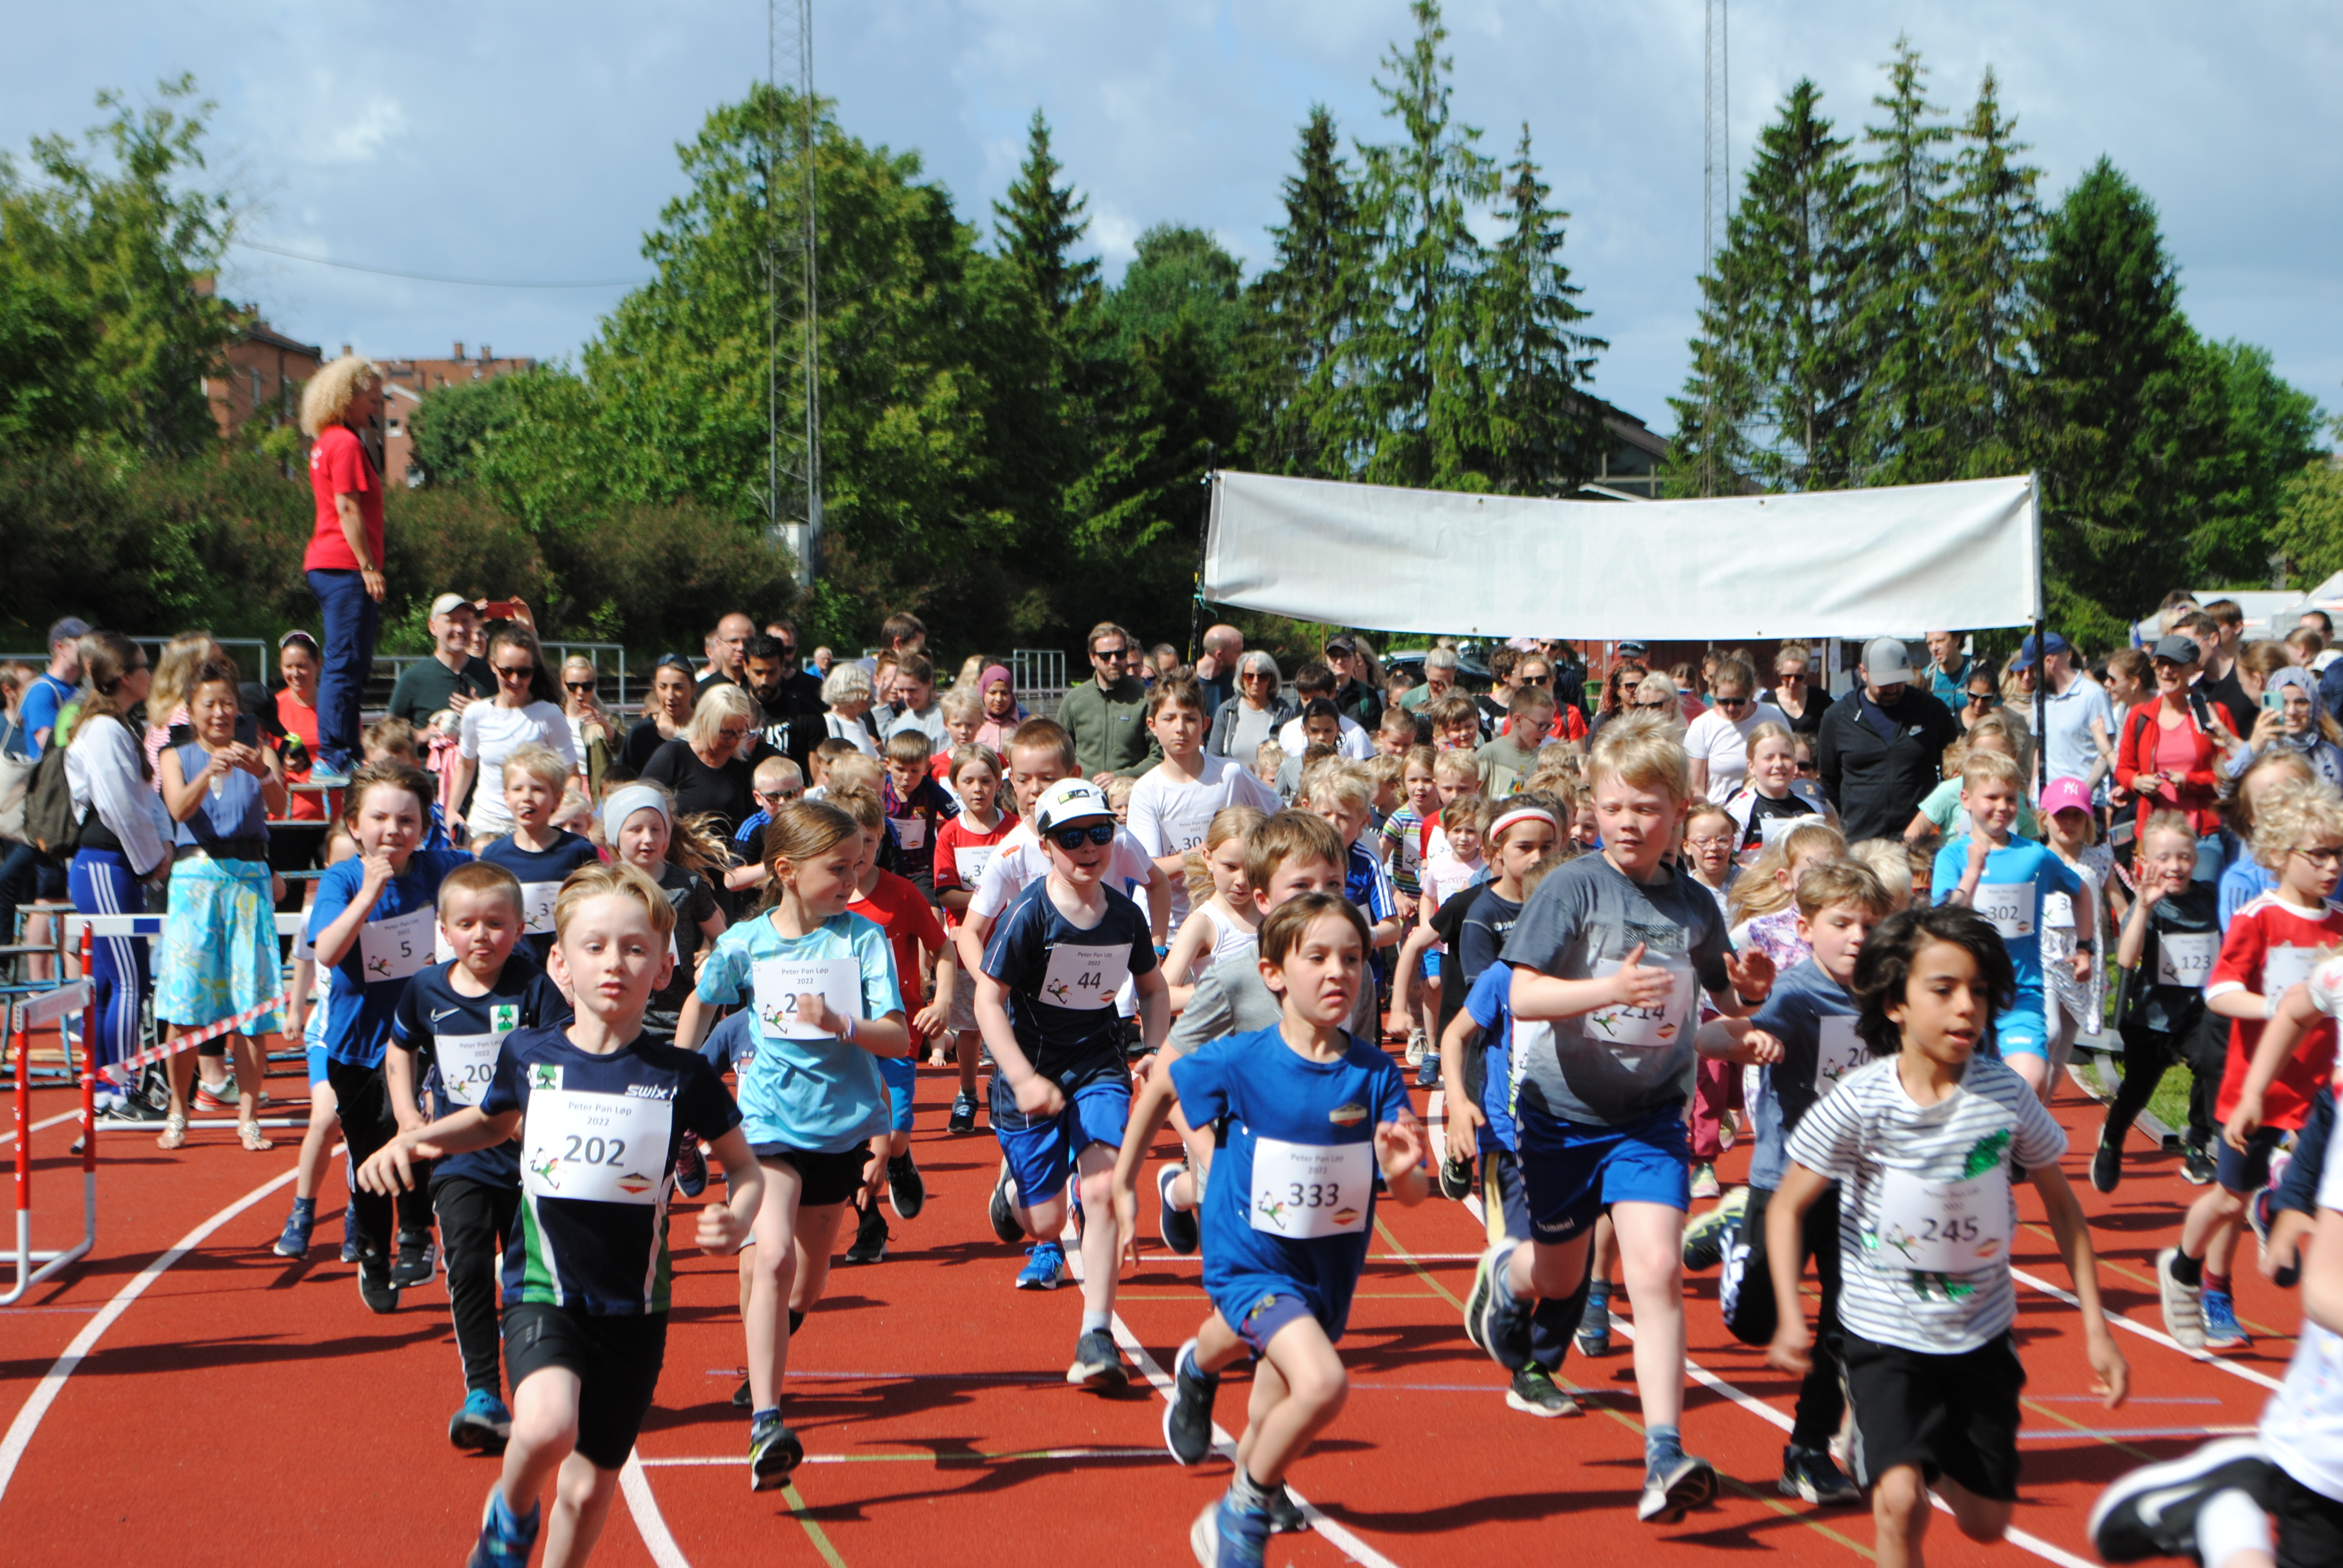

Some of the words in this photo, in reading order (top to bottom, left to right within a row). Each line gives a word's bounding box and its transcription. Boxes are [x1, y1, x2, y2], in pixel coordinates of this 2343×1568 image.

[759, 722, 790, 755] AST
[1988, 906, 2019, 920] 302
[401, 941, 412, 958] 5
[2181, 955, 2211, 970] 123
[1077, 972, 1101, 989] 44
[785, 991, 825, 1014] 21
[465, 1062, 497, 1083] 20
[569, 1102, 592, 1111] Peter
[615, 1106, 632, 1117] Løp
[587, 1117, 610, 1126] 2022
[563, 1135, 626, 1168] 202
[1291, 1154, 1312, 1162] Peter
[1316, 1154, 1329, 1163] Pan
[1308, 1166, 1328, 1175] 2022
[1288, 1183, 1339, 1208] 333
[1921, 1216, 1979, 1243] 245
